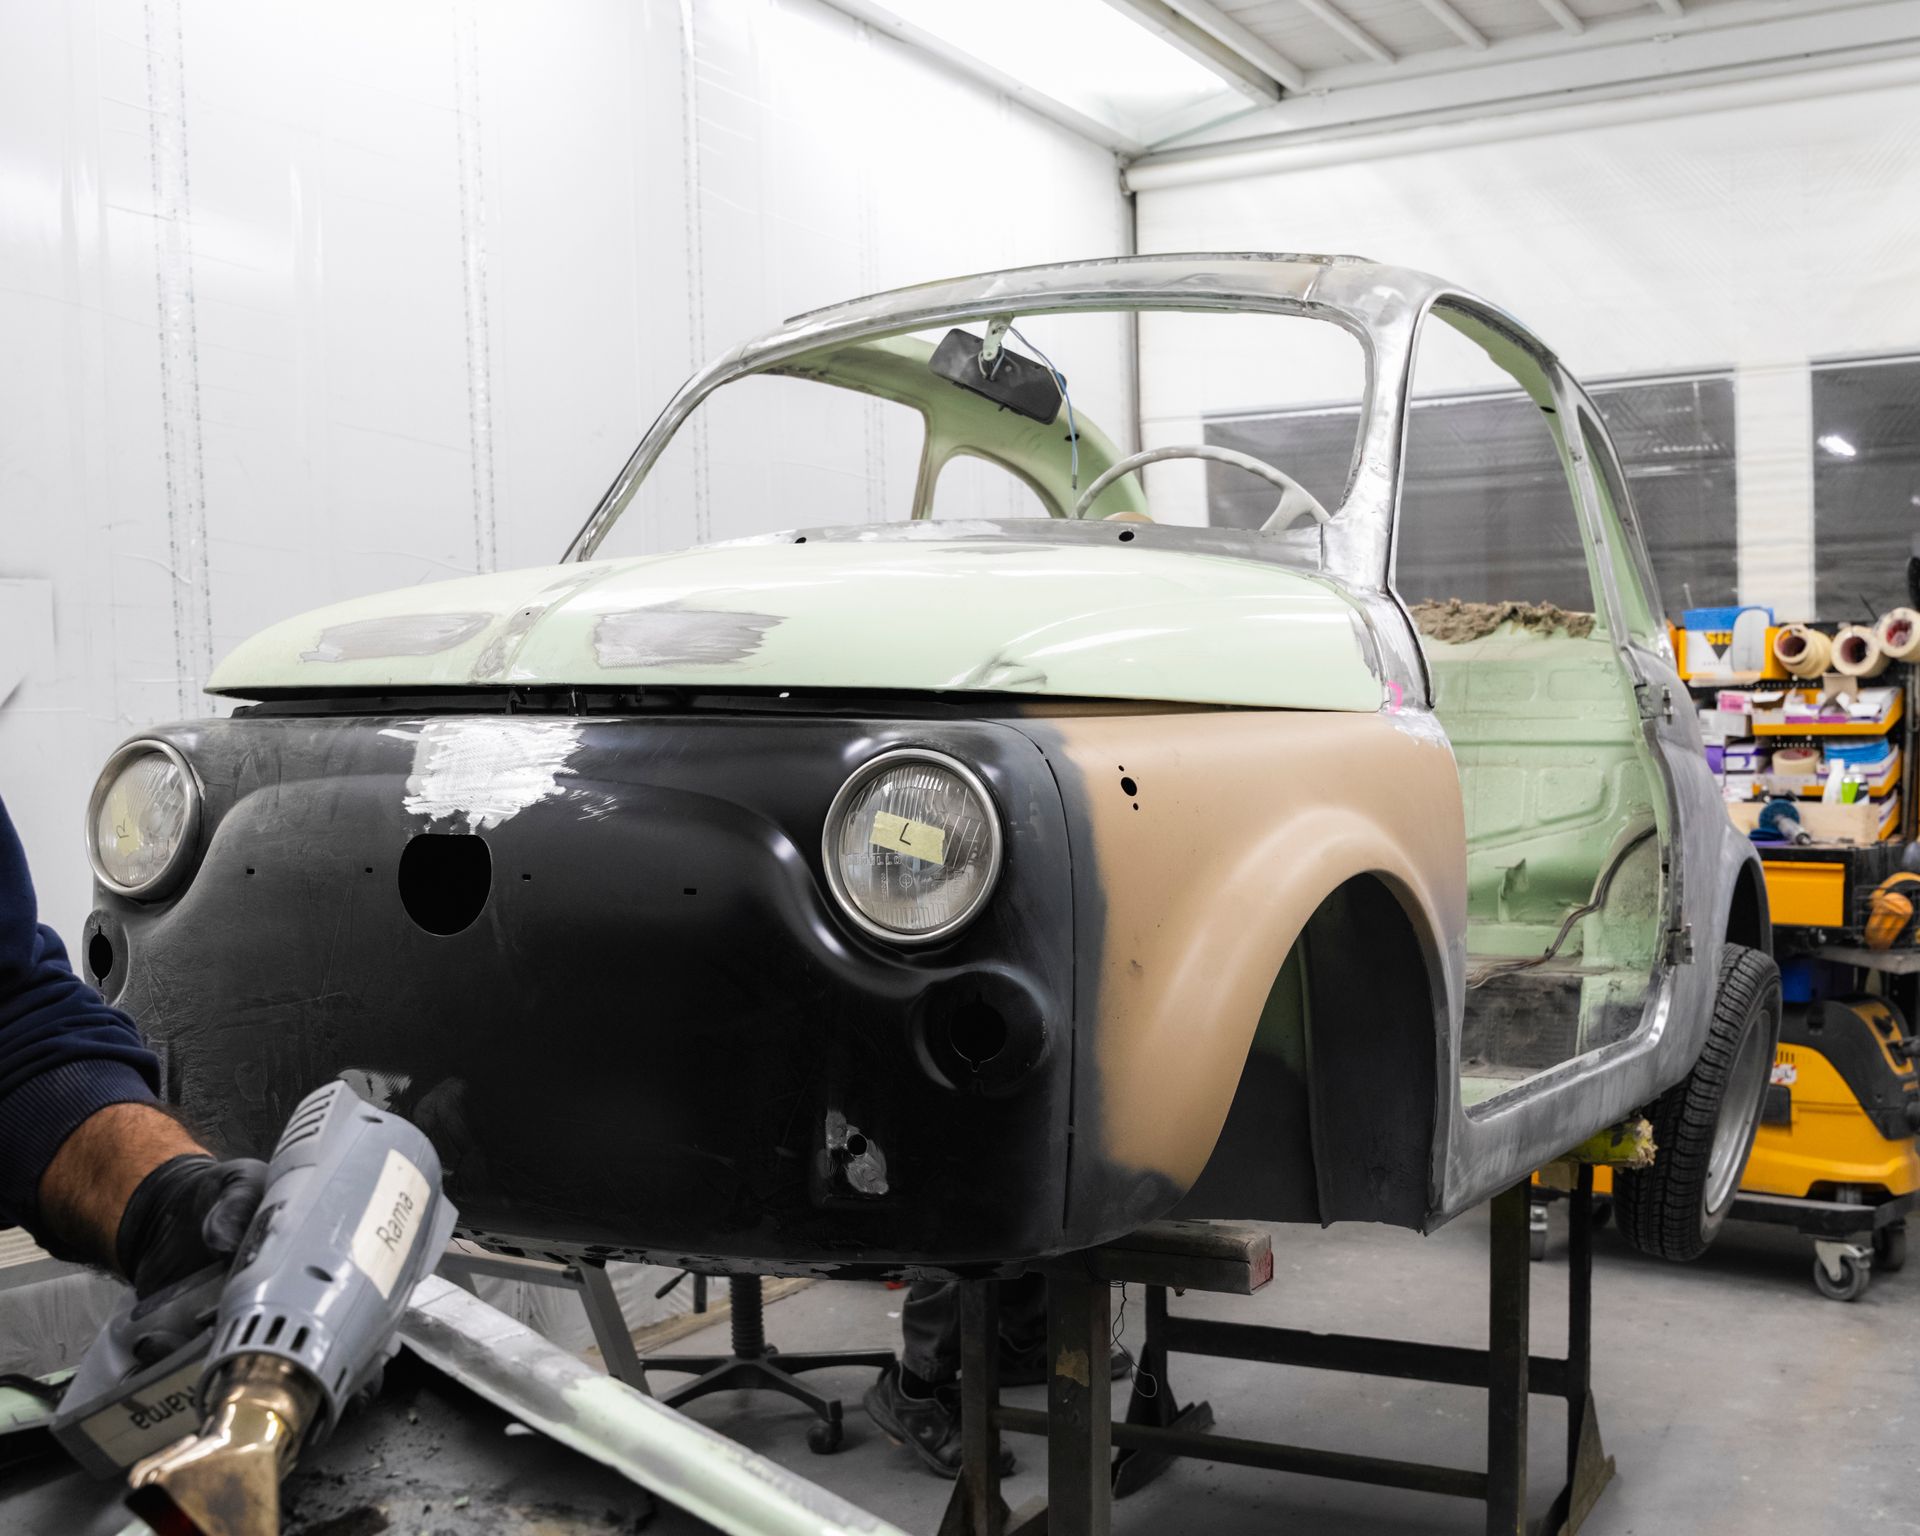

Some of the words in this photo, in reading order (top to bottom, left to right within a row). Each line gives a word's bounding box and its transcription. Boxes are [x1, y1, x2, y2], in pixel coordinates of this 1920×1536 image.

[116, 818, 130, 839] R
[899, 822, 912, 846] L
[375, 1191, 414, 1252] Rama
